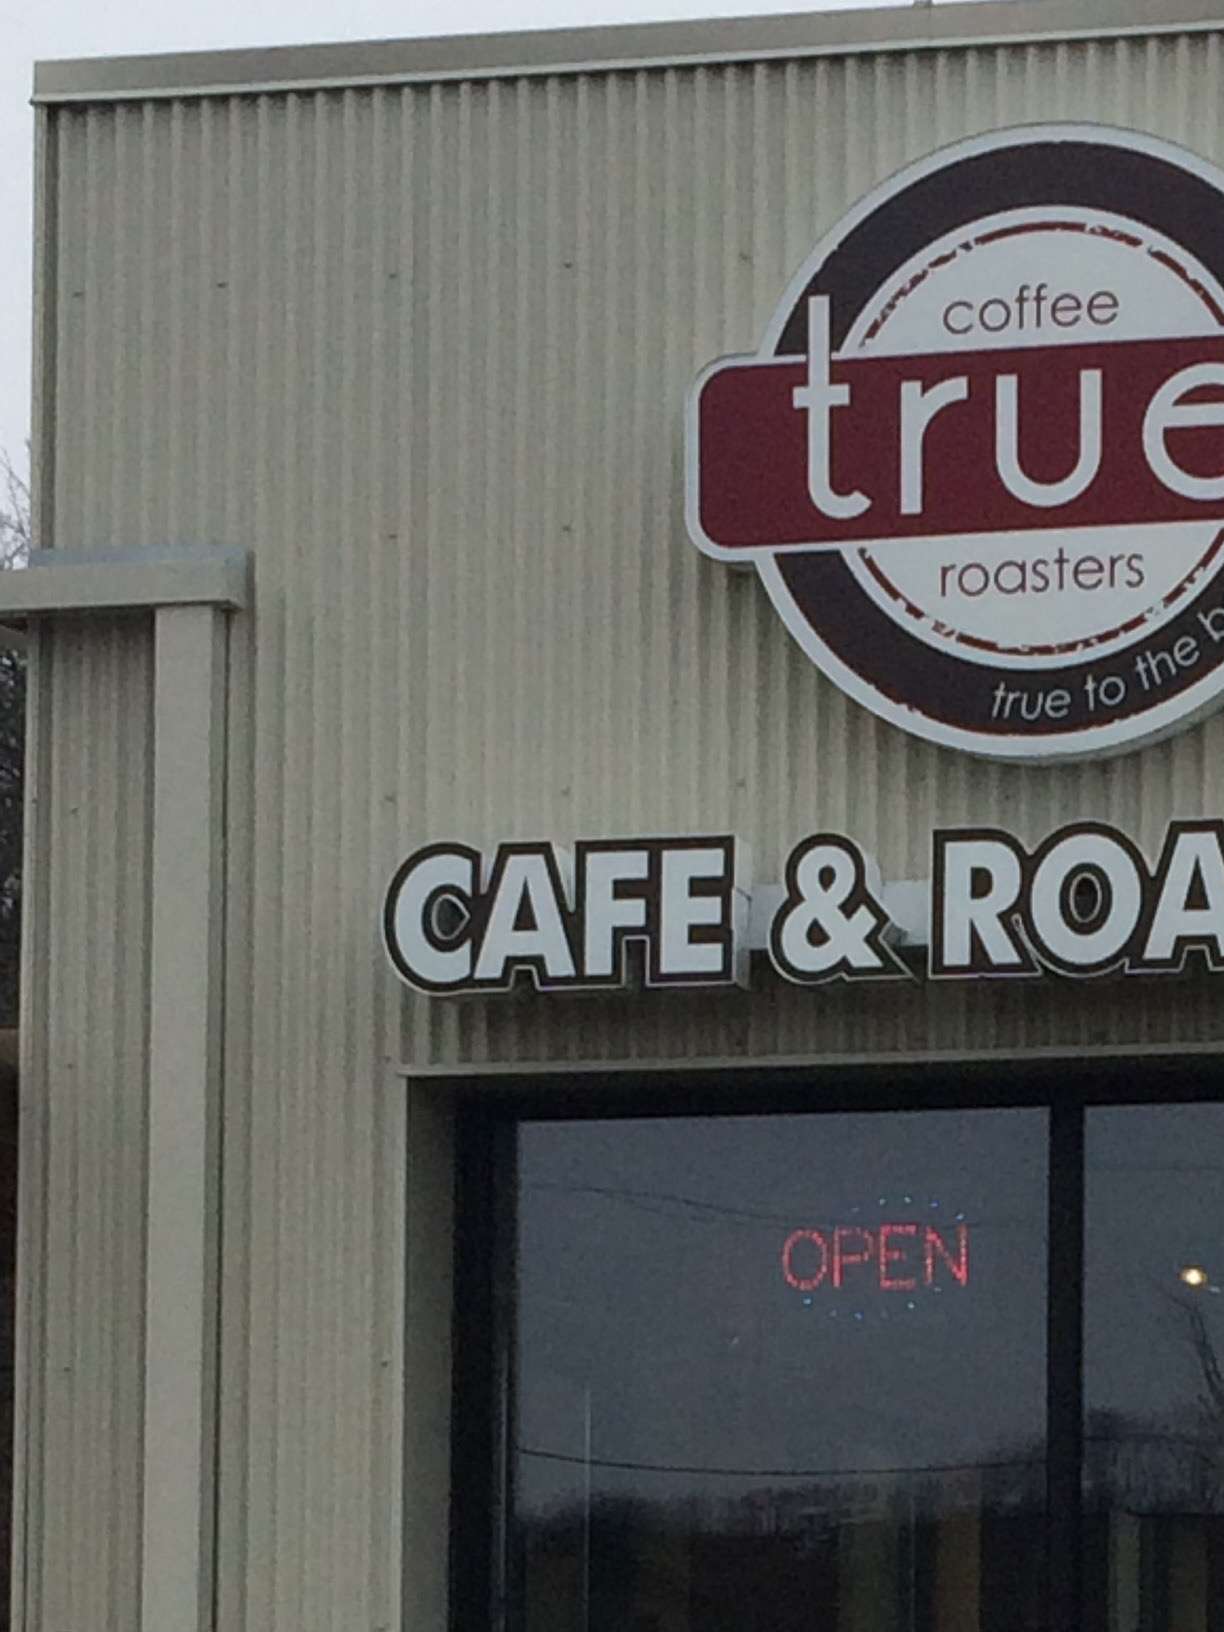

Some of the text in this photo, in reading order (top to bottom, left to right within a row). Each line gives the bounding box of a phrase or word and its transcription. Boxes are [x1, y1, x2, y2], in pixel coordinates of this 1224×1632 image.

[942, 284, 1120, 336] coffee
[938, 546, 1146, 599] roasters
[990, 682, 1071, 721] true
[1083, 672, 1126, 708] to
[1135, 636, 1201, 691] the
[392, 845, 728, 985] CAFE
[779, 842, 888, 973] &
[781, 1222, 970, 1291] OPEN
